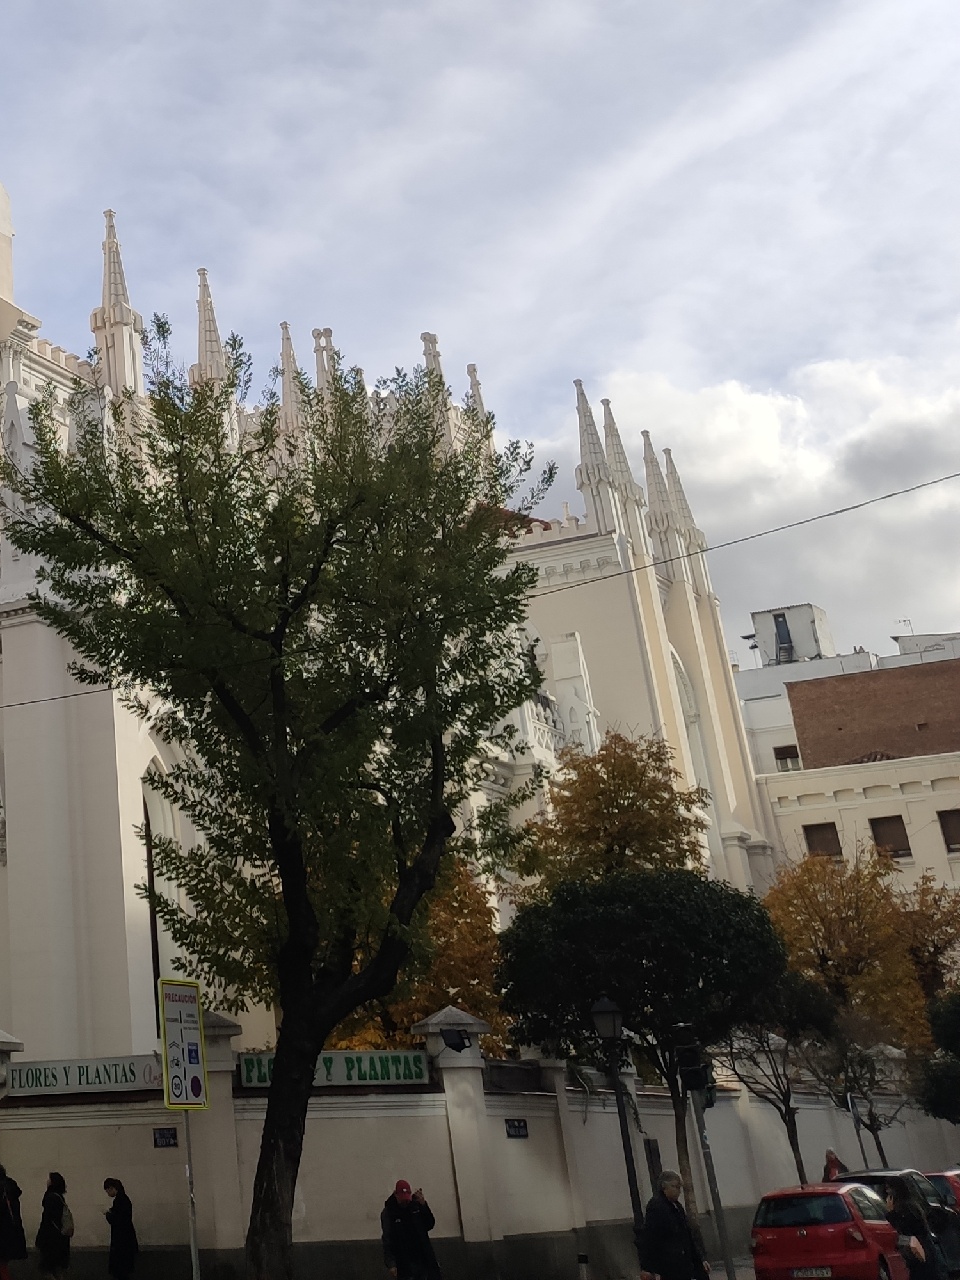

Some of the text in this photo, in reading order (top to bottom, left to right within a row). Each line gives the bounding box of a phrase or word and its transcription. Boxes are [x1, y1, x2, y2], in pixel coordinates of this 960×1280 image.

[10, 1067, 58, 1089] FLORES
[62, 1065, 71, 1086] Y
[77, 1062, 136, 1086] PLANTAS
[322, 1056, 333, 1081] Y
[344, 1055, 424, 1081] PLANTAS
